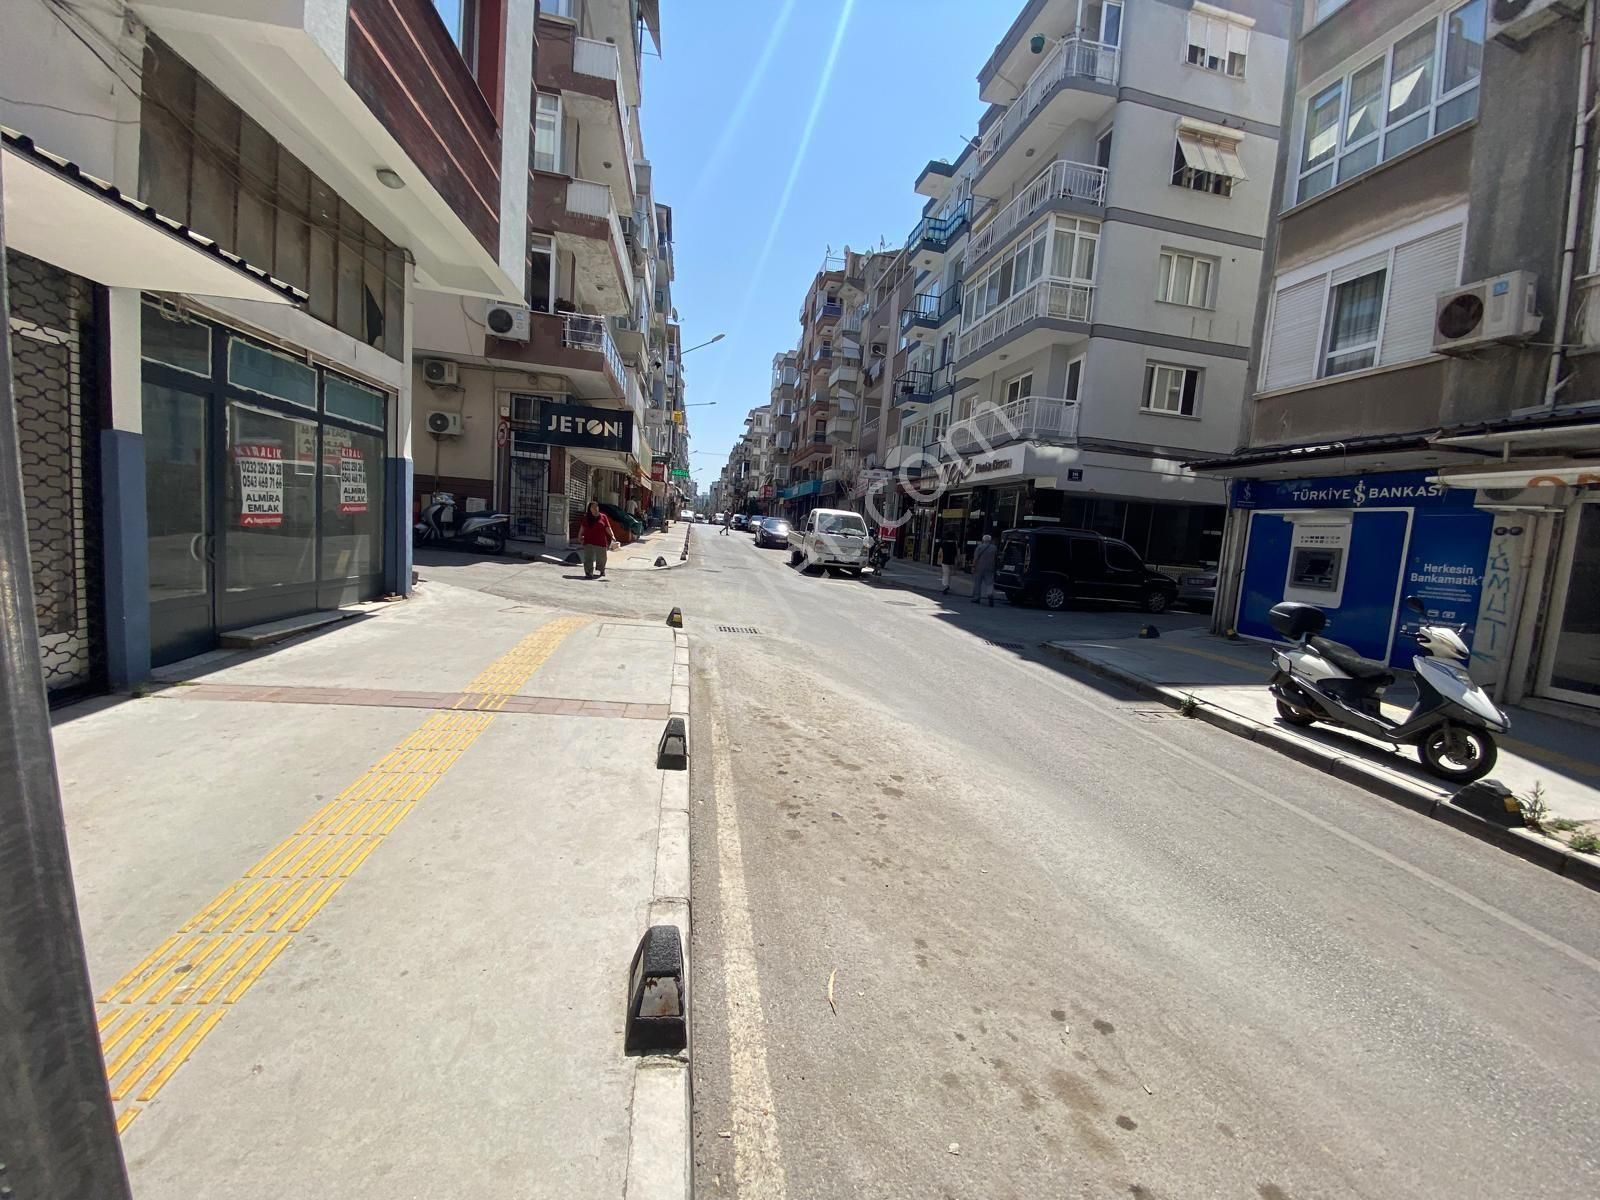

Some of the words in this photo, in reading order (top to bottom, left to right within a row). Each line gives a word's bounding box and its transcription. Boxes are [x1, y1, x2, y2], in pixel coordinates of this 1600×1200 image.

[547, 415, 618, 437] JETON
[1292, 487, 1350, 501] TÜRKİYE
[248, 504, 279, 513] EMLAK
[1424, 563, 1474, 575] Herkesin
